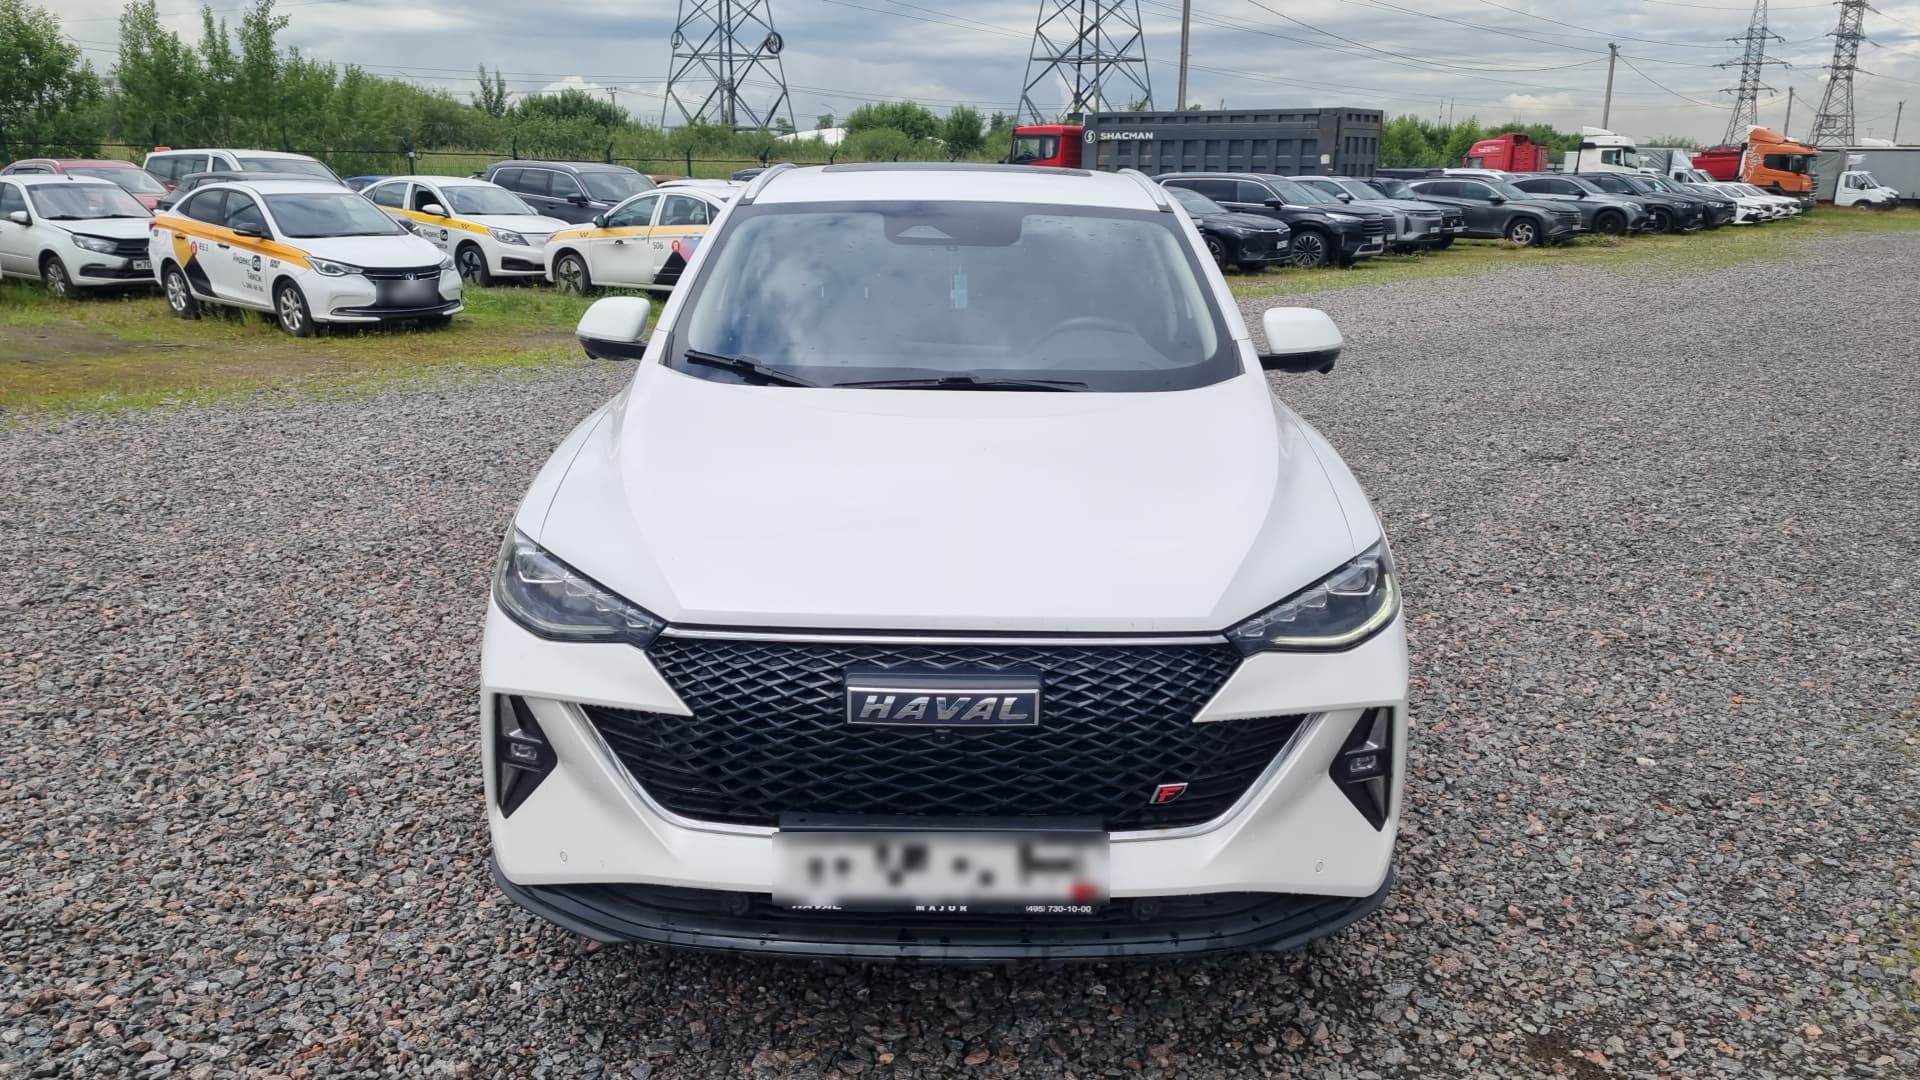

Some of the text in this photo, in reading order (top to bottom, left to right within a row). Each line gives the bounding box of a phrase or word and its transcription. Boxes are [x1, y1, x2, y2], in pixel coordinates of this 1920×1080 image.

[1100, 131, 1154, 140] SHACMAN
[859, 695, 1029, 721] HAVAL
[1156, 785, 1186, 802] F
[1047, 905, 1093, 913] 730-10-00
